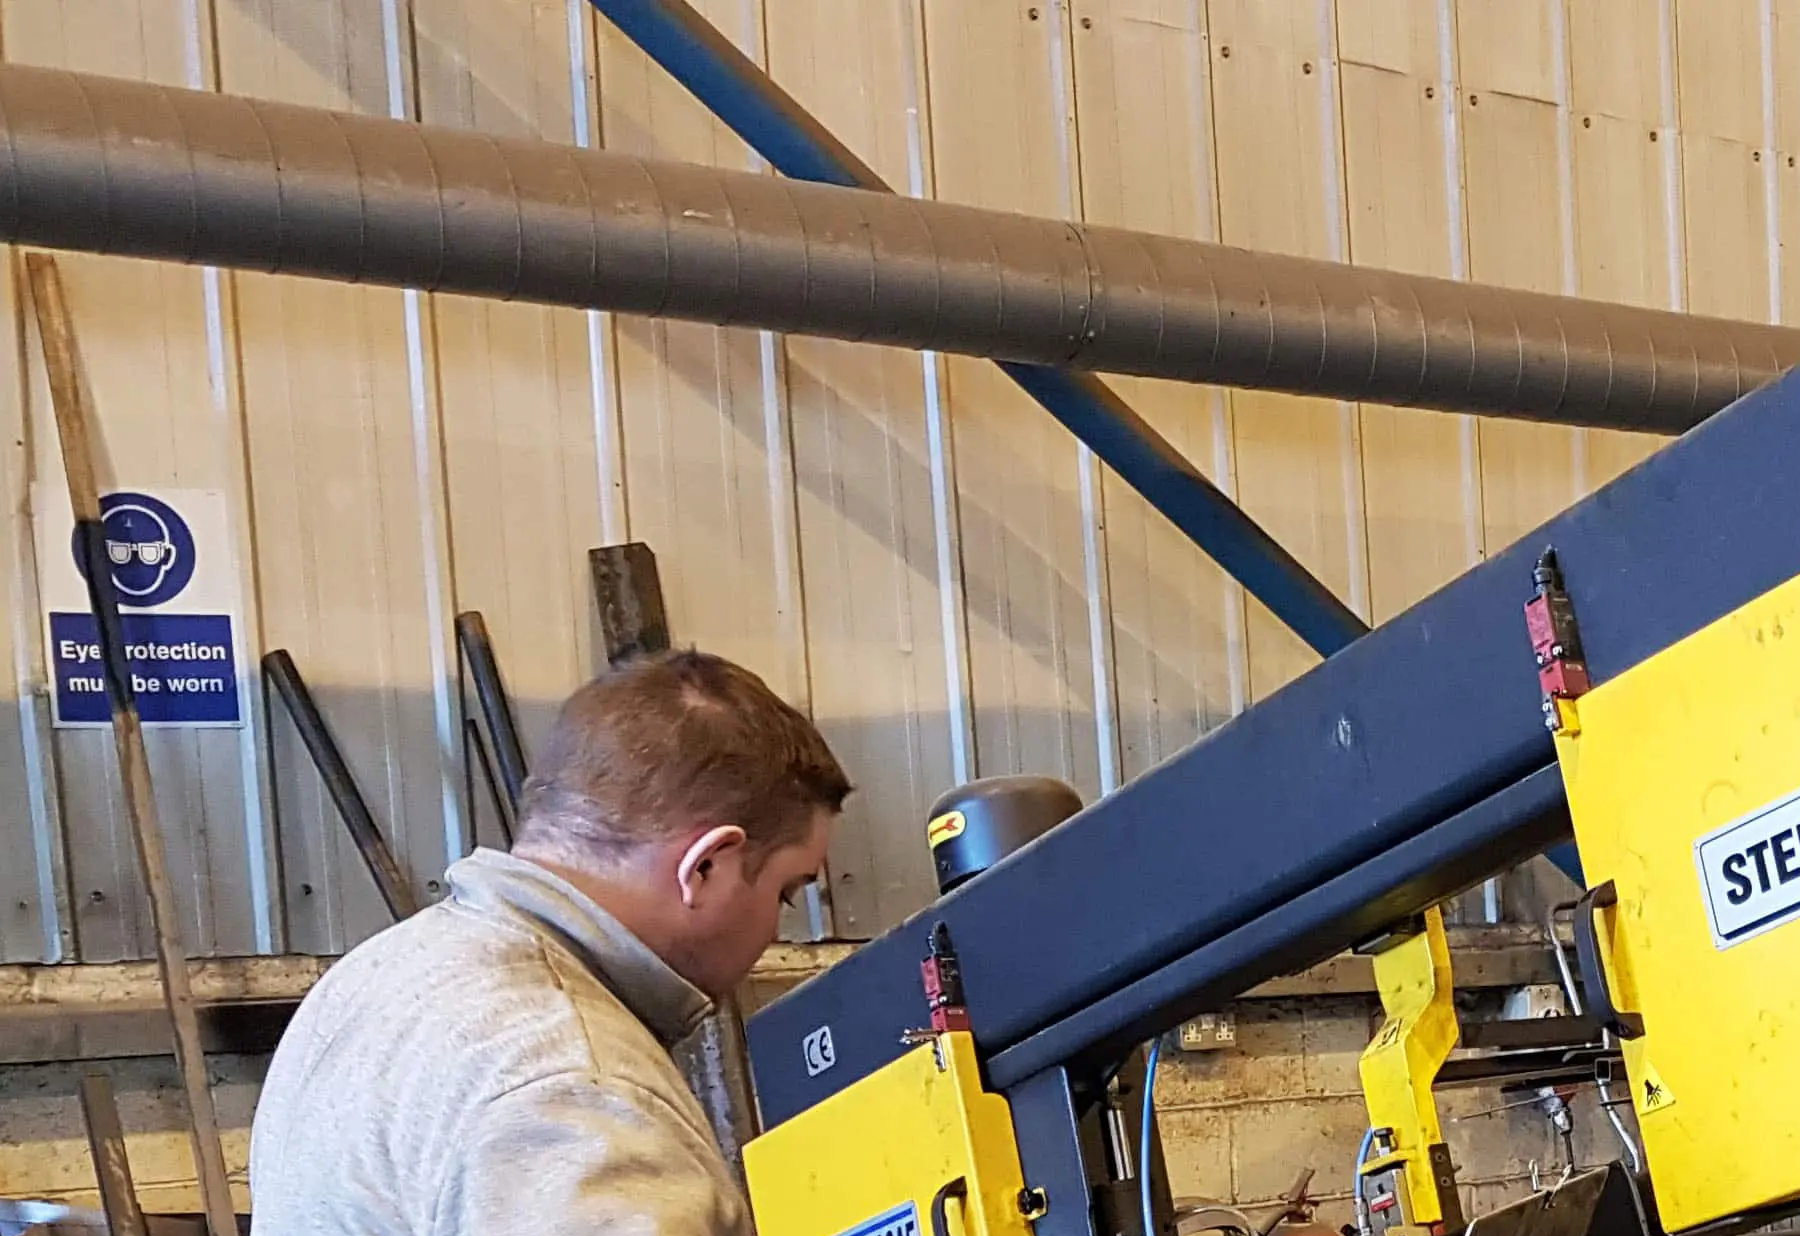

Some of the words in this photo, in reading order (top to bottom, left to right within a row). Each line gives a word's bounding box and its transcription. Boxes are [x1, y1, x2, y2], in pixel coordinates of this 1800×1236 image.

[60, 640, 101, 663] Eye
[123, 641, 226, 661] rotection
[131, 674, 161, 692] be
[167, 677, 224, 692] worn
[807, 1031, 832, 1070] CE
